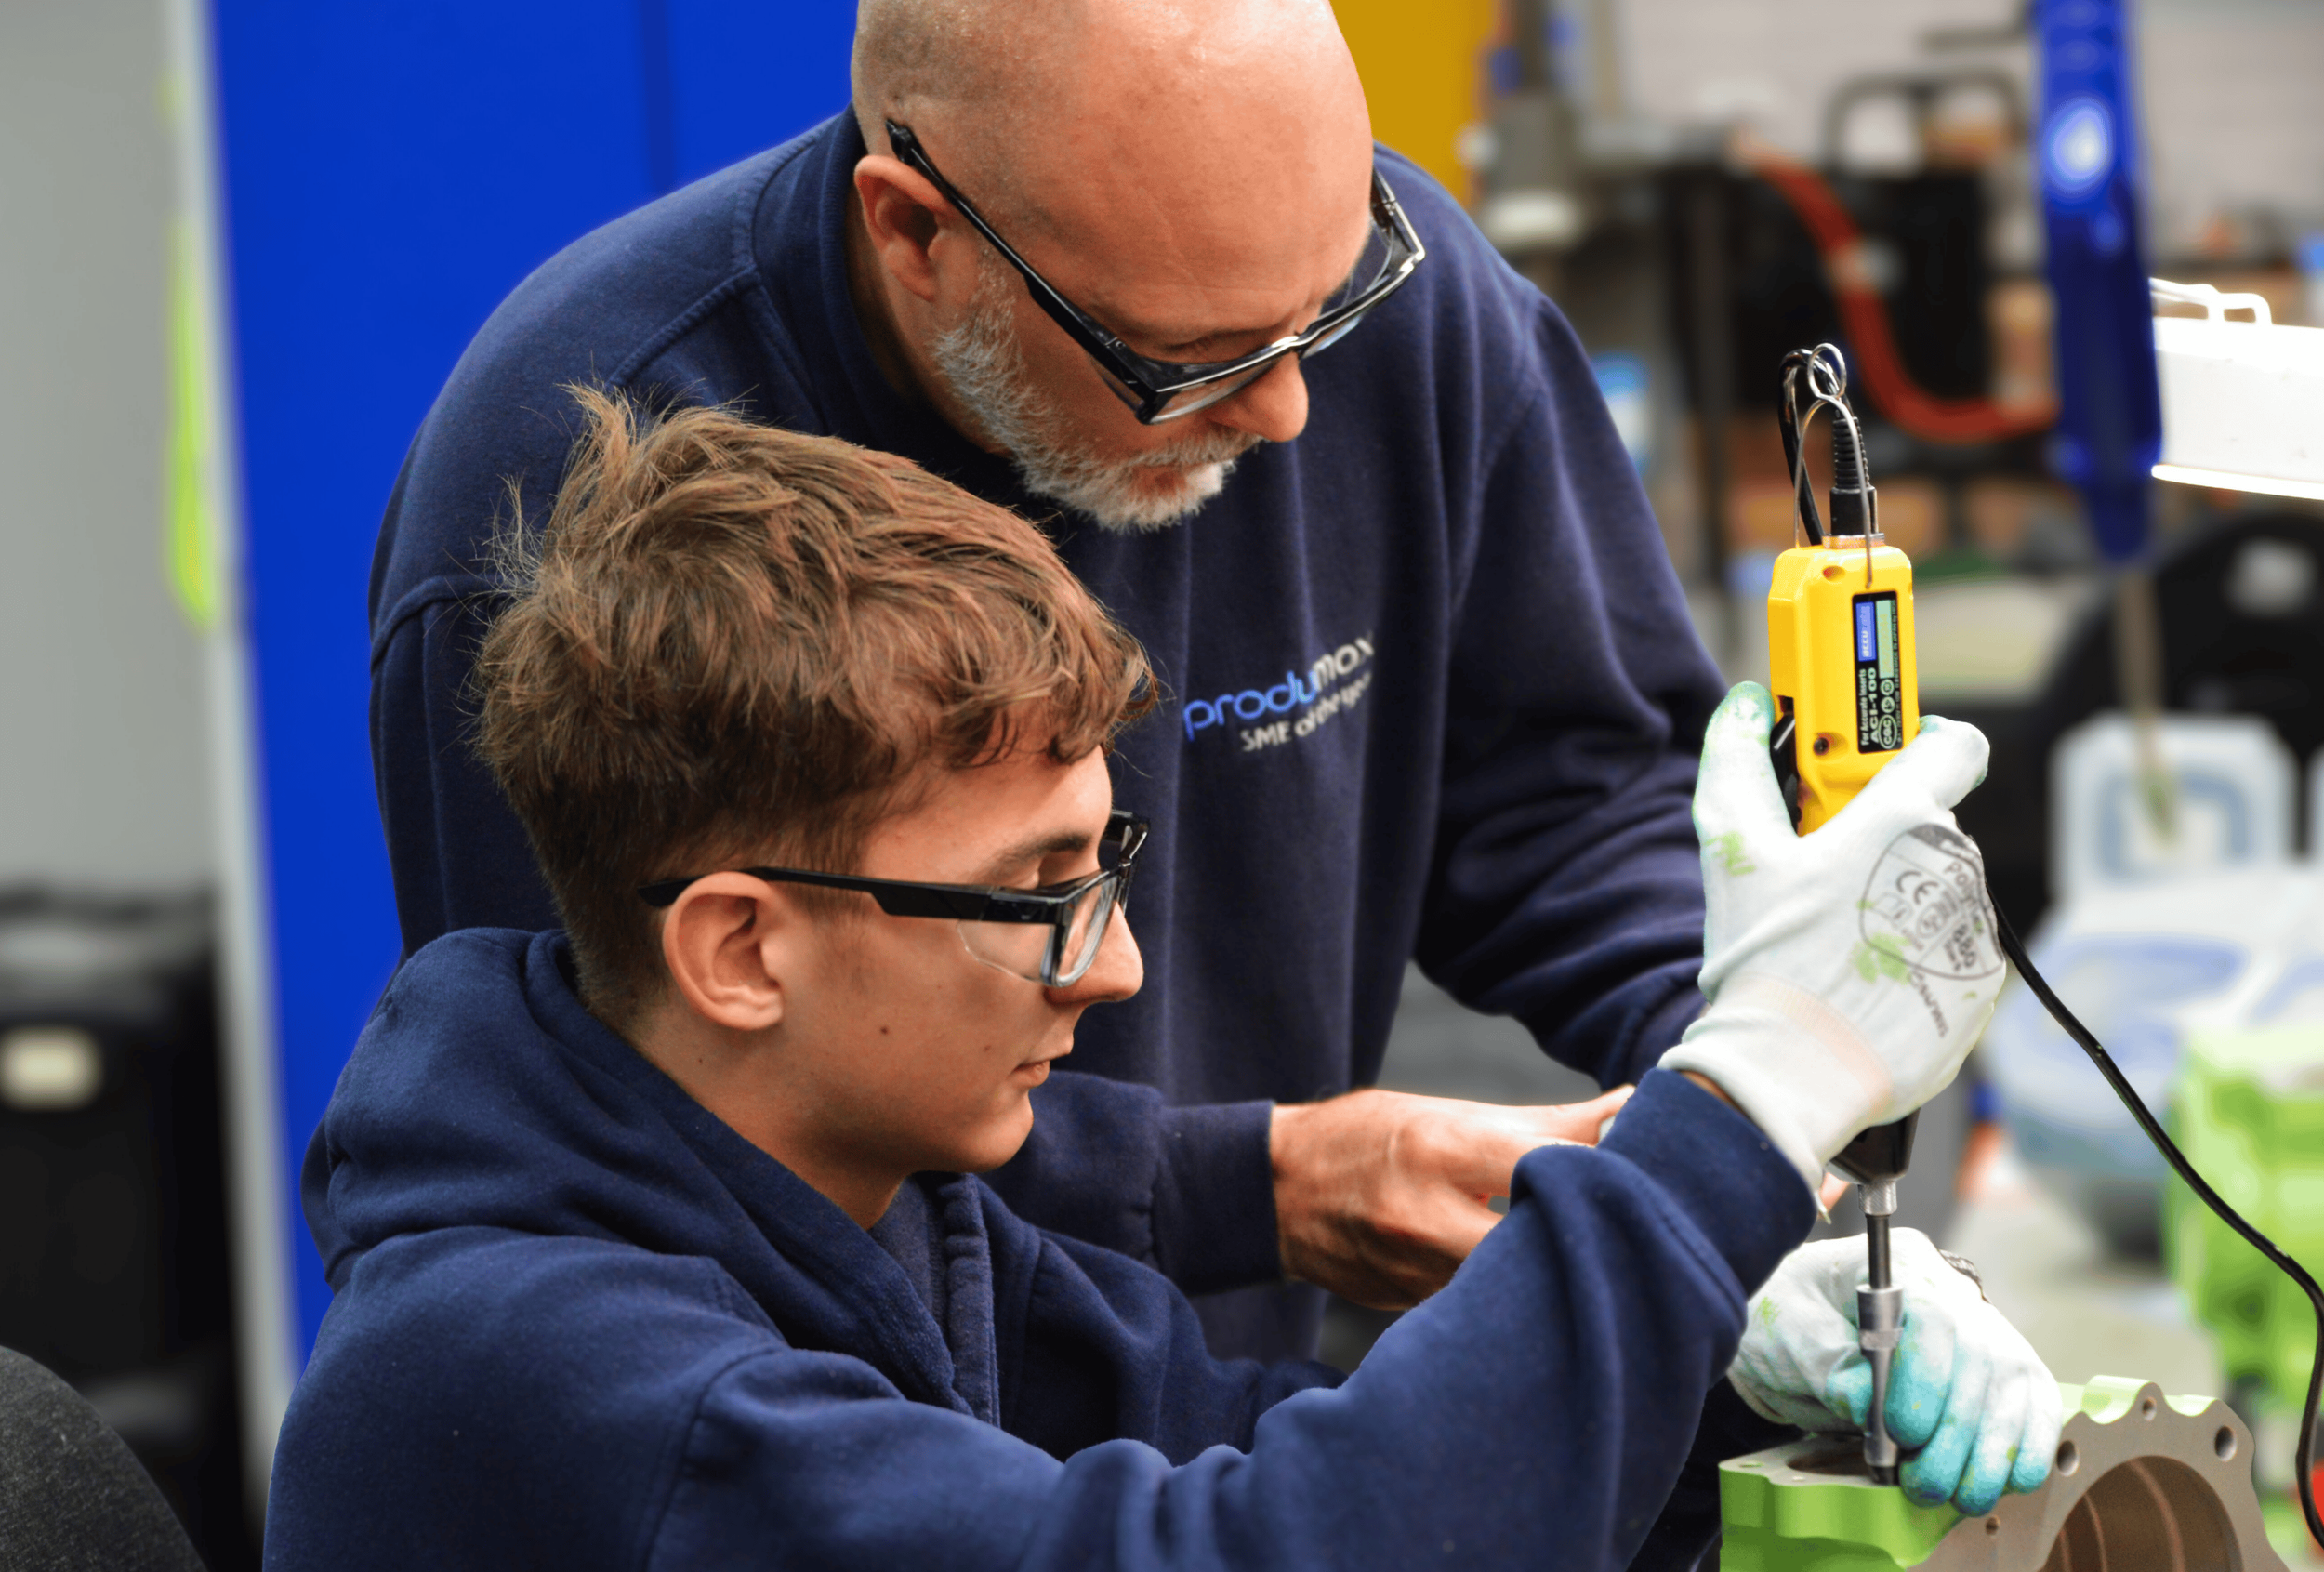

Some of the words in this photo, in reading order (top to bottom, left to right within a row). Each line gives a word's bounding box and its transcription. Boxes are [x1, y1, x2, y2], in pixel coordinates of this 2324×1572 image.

[1858, 668, 1868, 696] Inserts
[1859, 696, 1869, 732] Accurate
[1868, 667, 1880, 744] ACI-100
[1240, 720, 1291, 752] SME
[1860, 732, 1869, 746] For
